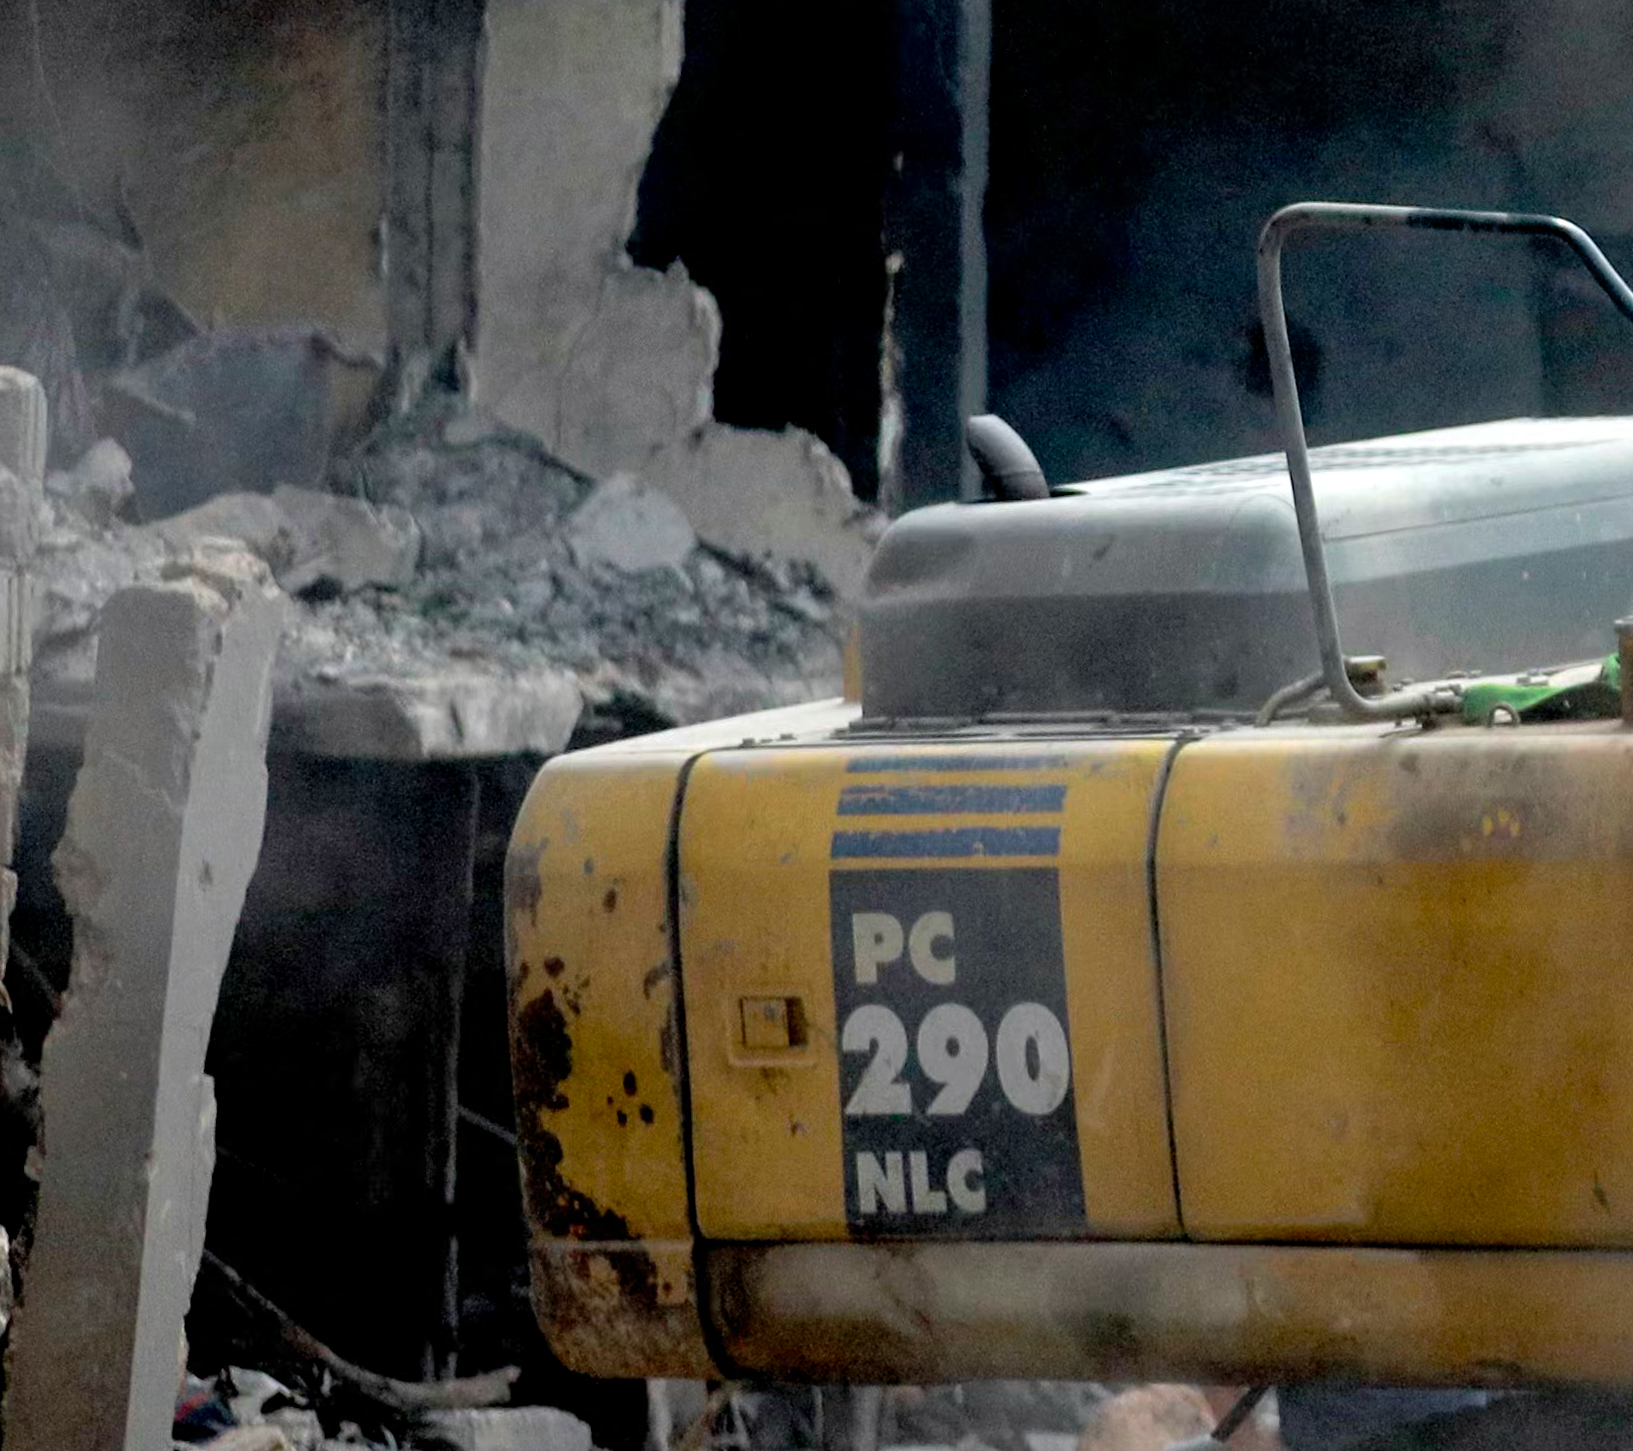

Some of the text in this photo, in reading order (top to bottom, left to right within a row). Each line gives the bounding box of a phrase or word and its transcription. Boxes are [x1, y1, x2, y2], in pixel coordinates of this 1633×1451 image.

[851, 911, 956, 986] PC
[841, 1001, 1071, 1115] 290
[856, 1148, 987, 1215] NLC
